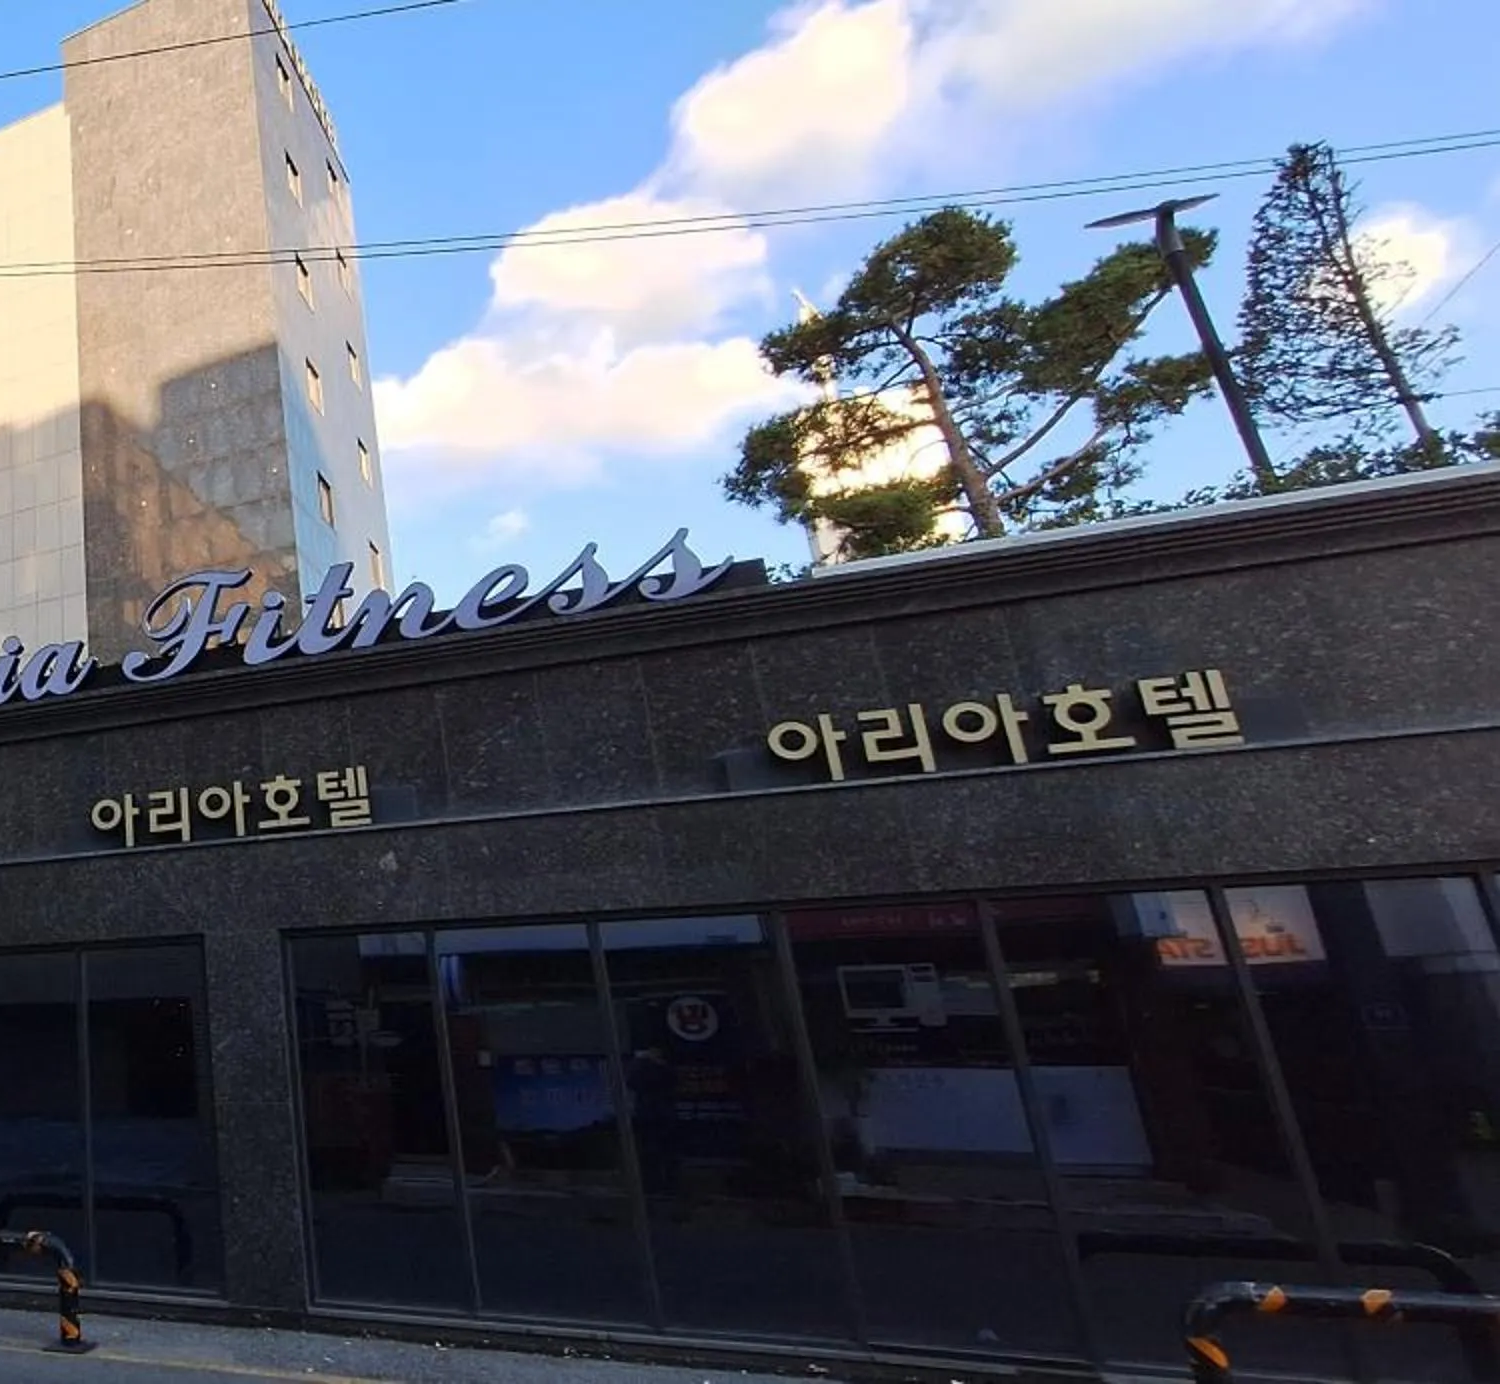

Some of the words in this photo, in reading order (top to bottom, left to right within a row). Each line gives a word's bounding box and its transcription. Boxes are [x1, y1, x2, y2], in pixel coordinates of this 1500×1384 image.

[121, 528, 735, 684] Fitness
[766, 669, 1245, 781] 아리아호텔
[90, 765, 374, 849] 아리아호텔
